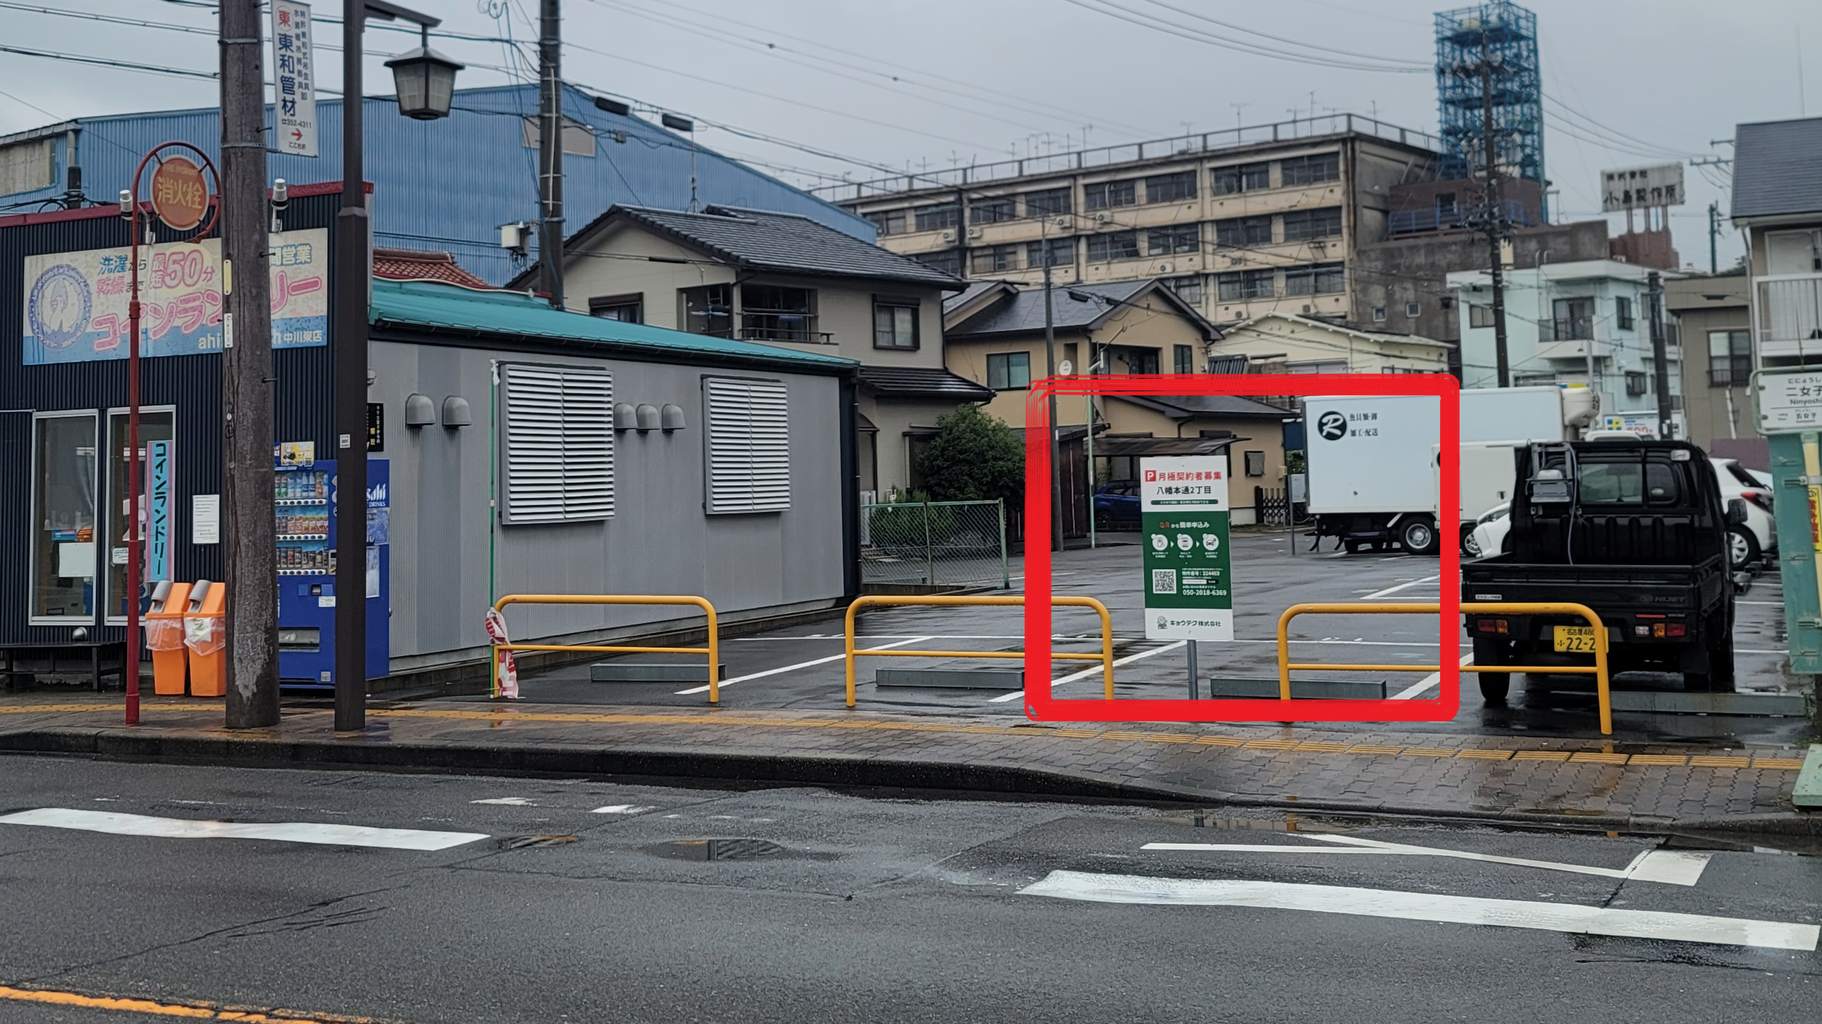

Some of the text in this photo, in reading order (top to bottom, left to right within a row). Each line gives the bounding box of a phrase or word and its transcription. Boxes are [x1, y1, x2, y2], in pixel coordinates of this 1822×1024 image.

[278, 10, 292, 27] 東
[277, 33, 297, 117] 東和管材
[286, 118, 312, 129] 352-4311
[157, 176, 204, 209] 消火栓
[283, 330, 323, 344] 中川東店
[1158, 471, 1222, 481] 月極契約者募集
[366, 482, 386, 501] sahi
[1156, 485, 1212, 495] 八幡本通2丁目
[154, 442, 168, 576] コインランドリー
[1566, 636, 1596, 651] 22-2
